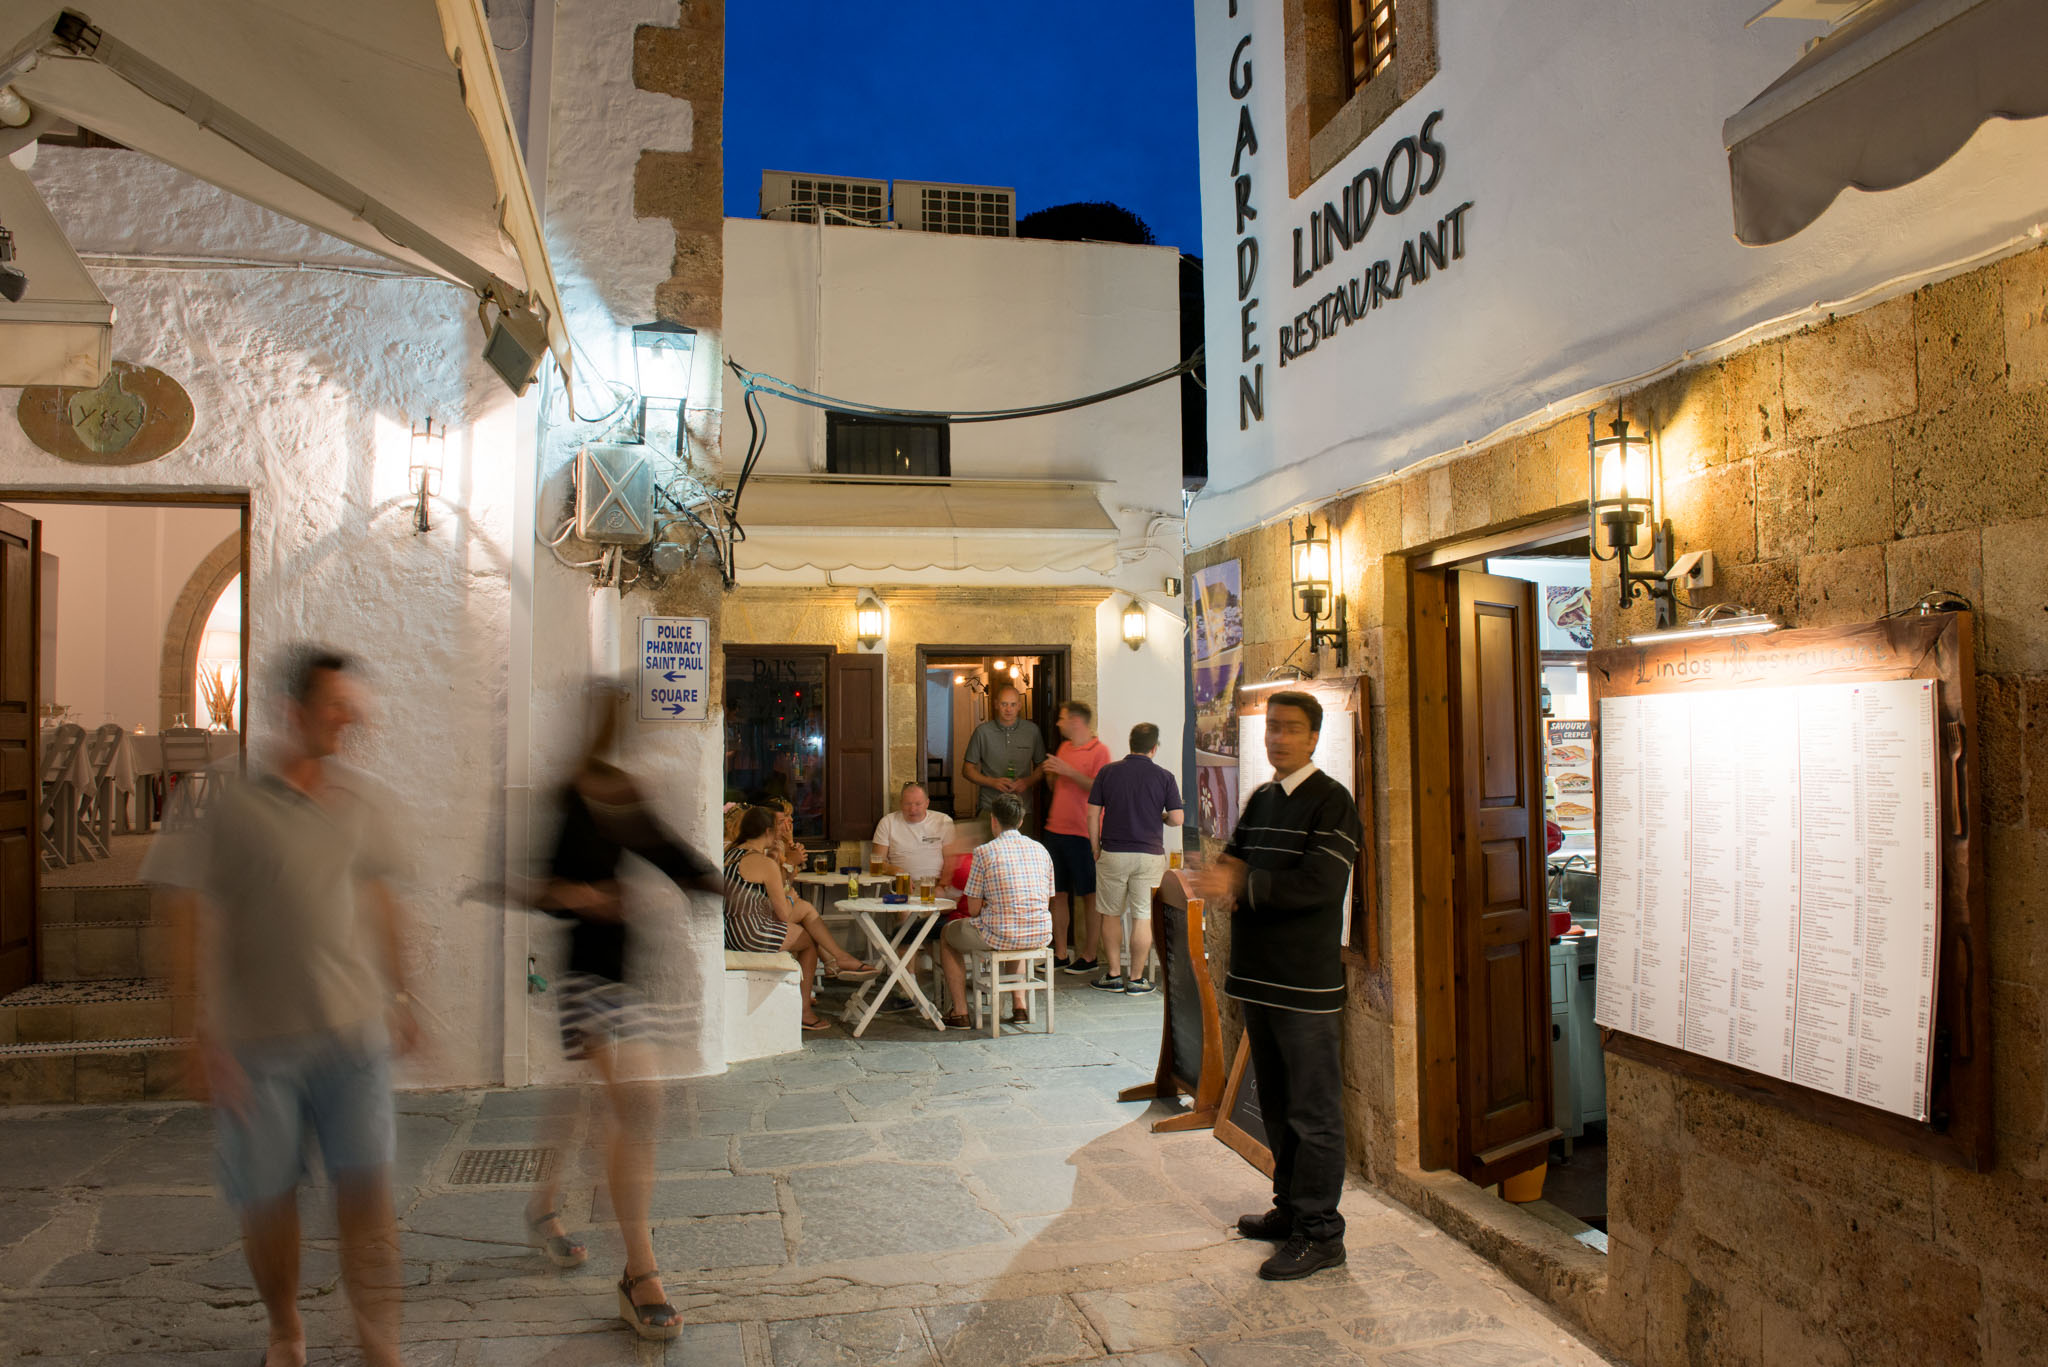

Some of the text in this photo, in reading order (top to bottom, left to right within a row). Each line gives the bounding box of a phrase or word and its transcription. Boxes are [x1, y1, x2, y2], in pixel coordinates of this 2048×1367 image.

[1293, 109, 1445, 289] LINDOS
[1228, 34, 1264, 431] GARDEN
[1279, 200, 1476, 369] RESTAURANT
[657, 625, 692, 639] POLICE
[646, 640, 702, 655] PHARMACY
[645, 656, 703, 670] SAINT PAUL
[1635, 645, 1712, 685] Lindos
[651, 688, 698, 703] SQUARE
[1550, 721, 1588, 731] SAVOURY
